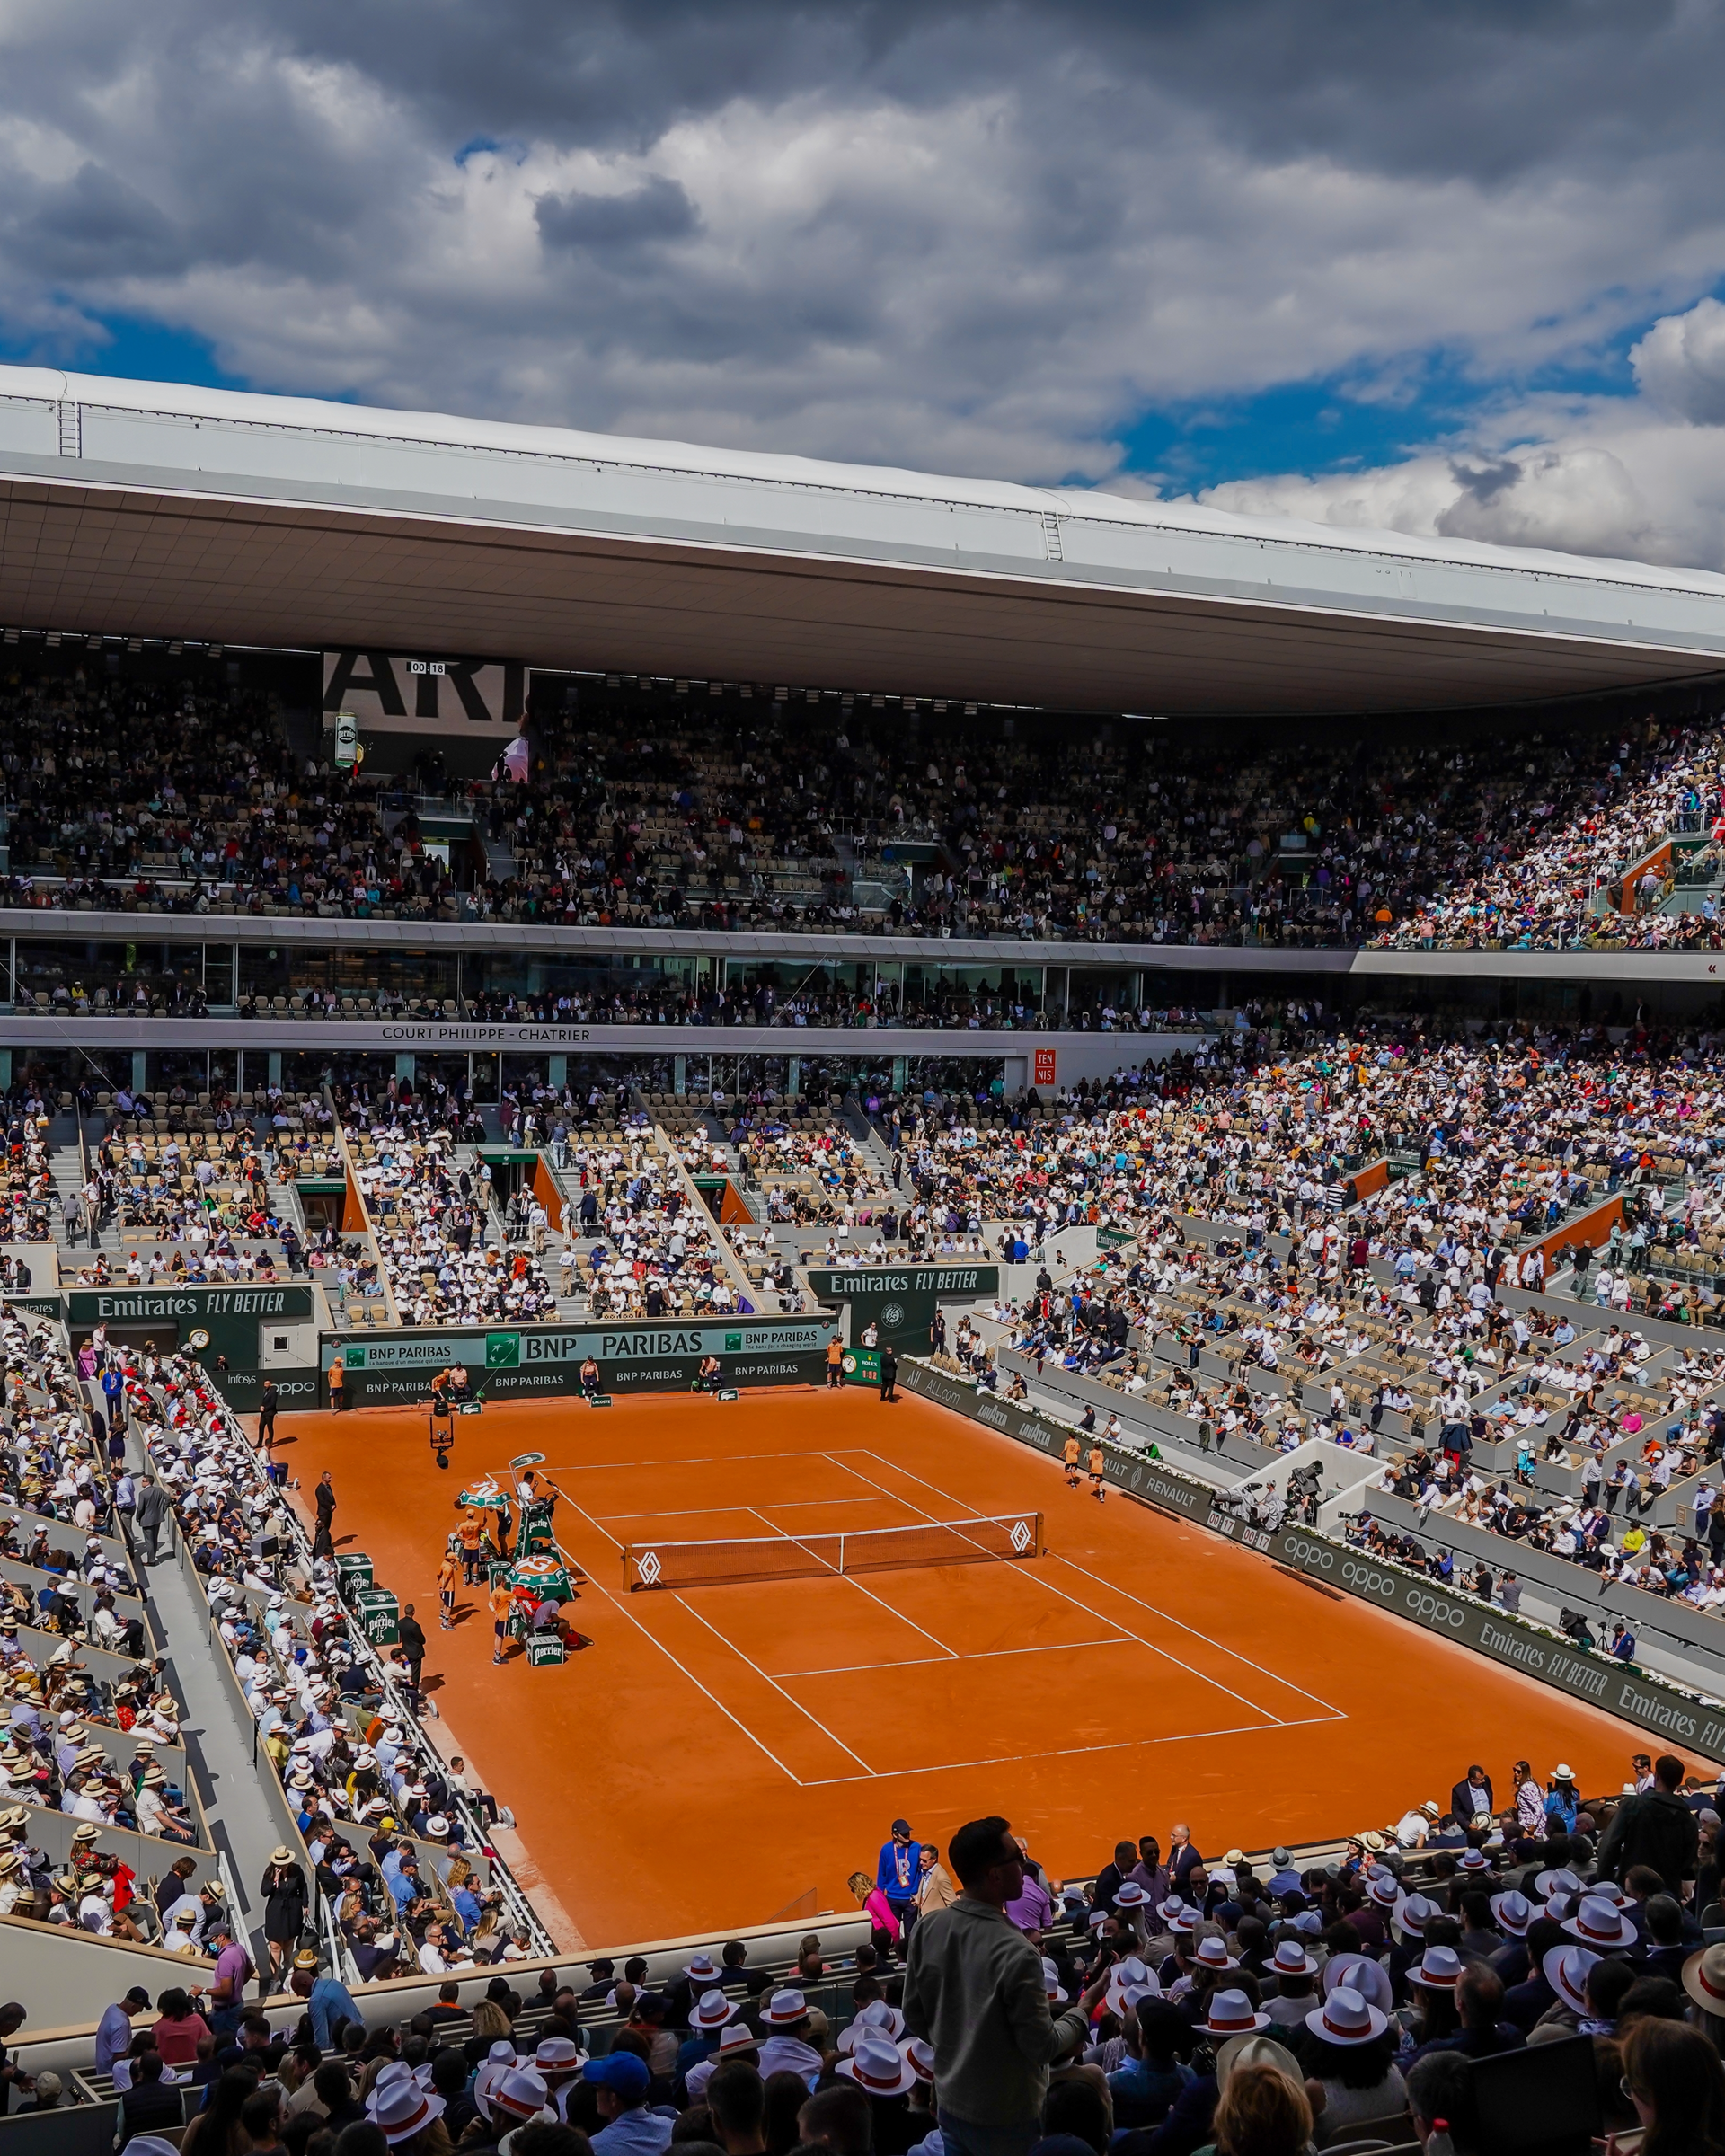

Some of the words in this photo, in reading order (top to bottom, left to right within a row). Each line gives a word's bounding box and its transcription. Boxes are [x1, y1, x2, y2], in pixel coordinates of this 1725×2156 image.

[382, 1027, 434, 1038] COURT
[439, 1028, 505, 1039] PHILIPPE
[518, 1029, 590, 1041] CHATRIER
[1038, 1054, 1052, 1064] TEN
[1038, 1070, 1052, 1080] NIS
[1097, 1233, 1120, 1247] Emirates
[831, 1274, 908, 1293] Emirates
[916, 1272, 937, 1290] FLY
[937, 1270, 978, 1289] BETTER
[97, 1295, 197, 1317] Emirates
[206, 1294, 230, 1314] FLY
[233, 1292, 285, 1313] BETTER
[526, 1337, 577, 1359] BNP
[602, 1331, 703, 1356] PARIBAS
[745, 1334, 768, 1344] BNP
[771, 1330, 818, 1343] PARIBAS
[369, 1348, 395, 1359] BNP
[399, 1346, 451, 1358] PARIBAS
[227, 1374, 257, 1385] Infosys
[616, 1372, 638, 1382] BNP
[640, 1369, 683, 1381] PARIBAS
[735, 1366, 755, 1375] BNP
[756, 1364, 799, 1374] PARIBAS
[367, 1383, 390, 1392] BNP
[392, 1381, 432, 1392] PARIBA
[495, 1377, 518, 1387] BNP
[519, 1375, 564, 1386] PARIBAS
[924, 1379, 960, 1406] ALL.com
[977, 1403, 1009, 1428] LAVAZZA
[1018, 1421, 1052, 1448] LAVAZZA
[1083, 1449, 1128, 1477] RAULT
[1146, 1477, 1198, 1508] RENAULT
[1284, 1536, 1334, 1569] oppo
[344, 1578, 370, 1595] perrier
[1341, 1561, 1395, 1596] oppo
[1406, 1589, 1465, 1628] oppo
[368, 1617, 396, 1637] perrier
[535, 1645, 562, 1666] perrier
[1479, 1622, 1546, 1669] Emirates
[1547, 1653, 1571, 1679] FLY
[1565, 1662, 1609, 1697] BETTER
[1618, 1683, 1697, 1737] Emirates
[1699, 1720, 1725, 1748] FLY
